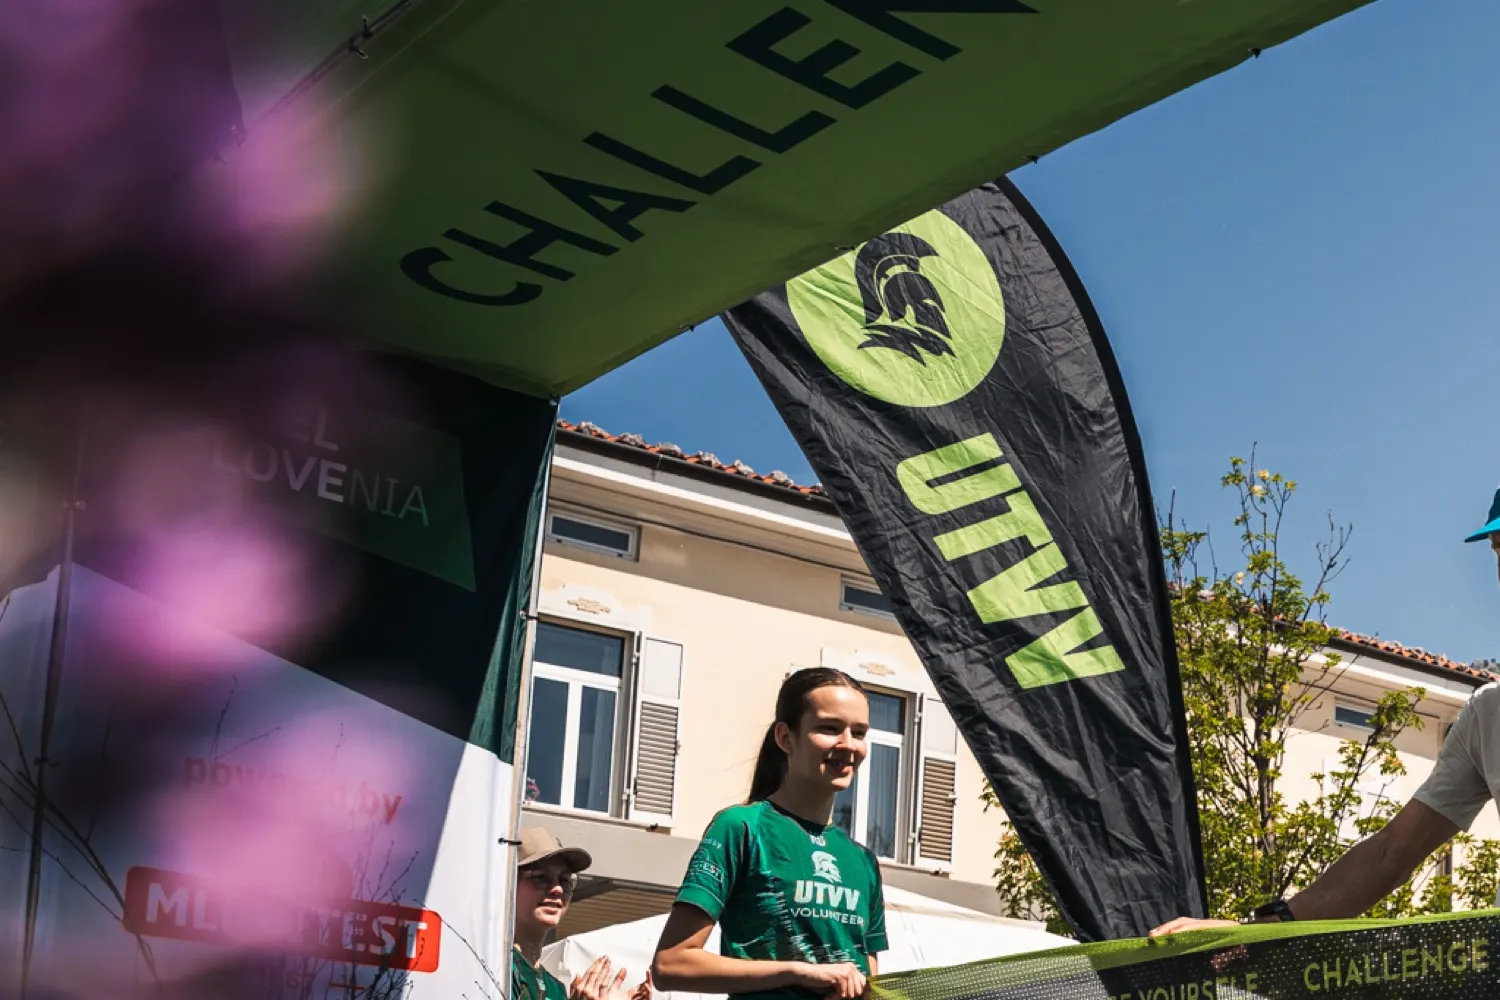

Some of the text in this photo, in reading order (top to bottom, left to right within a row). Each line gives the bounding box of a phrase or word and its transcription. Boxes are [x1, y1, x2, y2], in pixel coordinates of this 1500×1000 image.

[212, 440, 430, 527] LOVENIA
[896, 432, 1126, 690] UTVV
[146, 882, 428, 959] MLTEST
[788, 906, 866, 927] VOLUNTEER
[793, 879, 861, 912] UTVV
[1302, 938, 1490, 992] CHALLENGE
